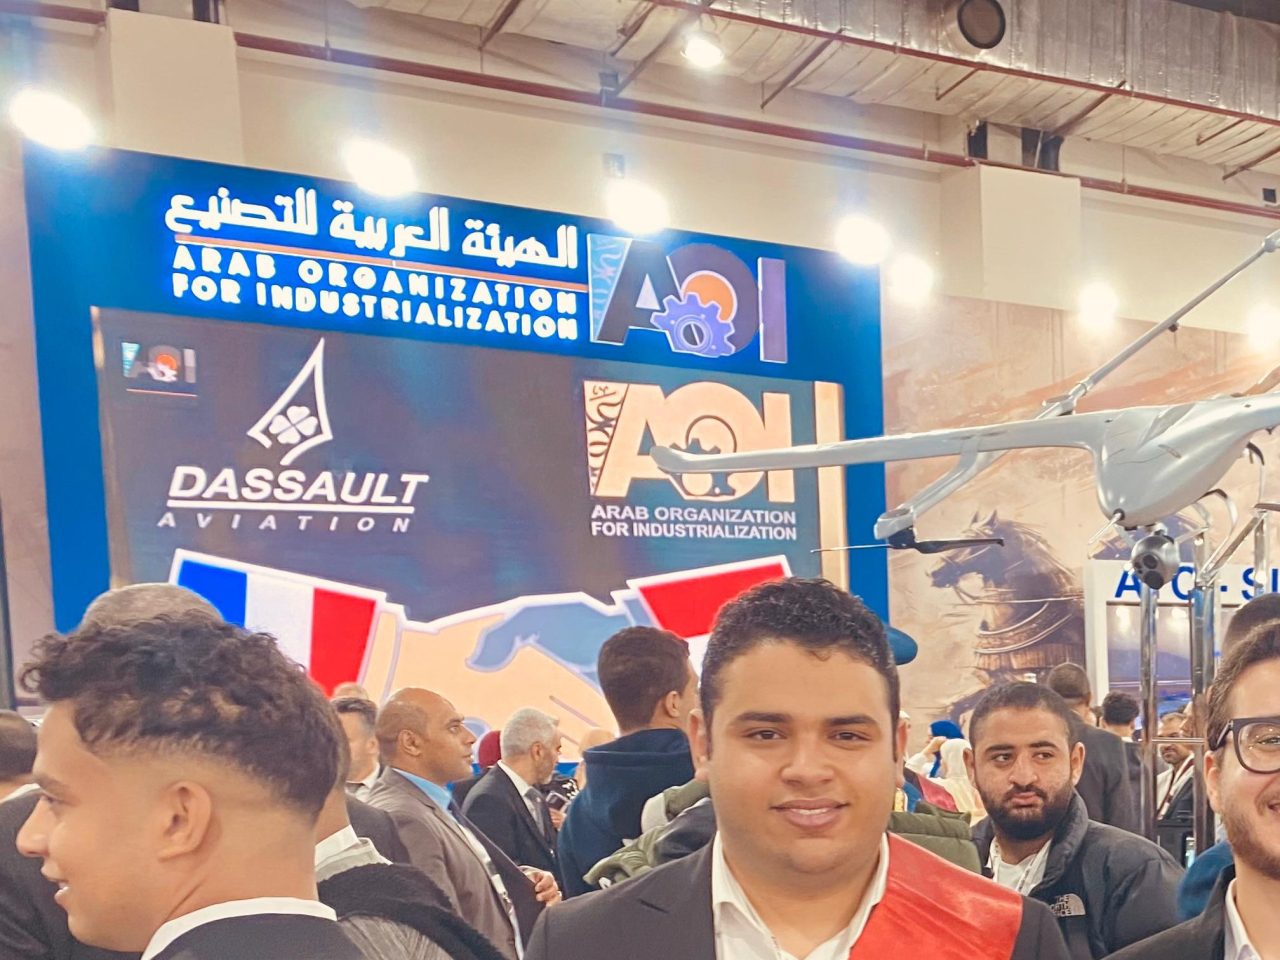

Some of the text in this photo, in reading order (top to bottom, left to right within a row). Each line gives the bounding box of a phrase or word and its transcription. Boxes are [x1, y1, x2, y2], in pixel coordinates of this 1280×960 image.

[165, 187, 578, 269] الهيئة العربية للتصنيع
[172, 244, 577, 316] ARAB ORGANIZATION
[172, 272, 578, 341] FOR INDUSTRIALIZATION
[594, 235, 788, 364] AOI
[590, 381, 796, 503] AOI
[168, 465, 429, 504] DASSAULT
[157, 512, 411, 533] AVIATION
[591, 505, 796, 525] ARAB ORGANIZATION
[591, 522, 797, 540] FOR INDUSTRIALIZATION
[1114, 566, 1195, 600] AC
